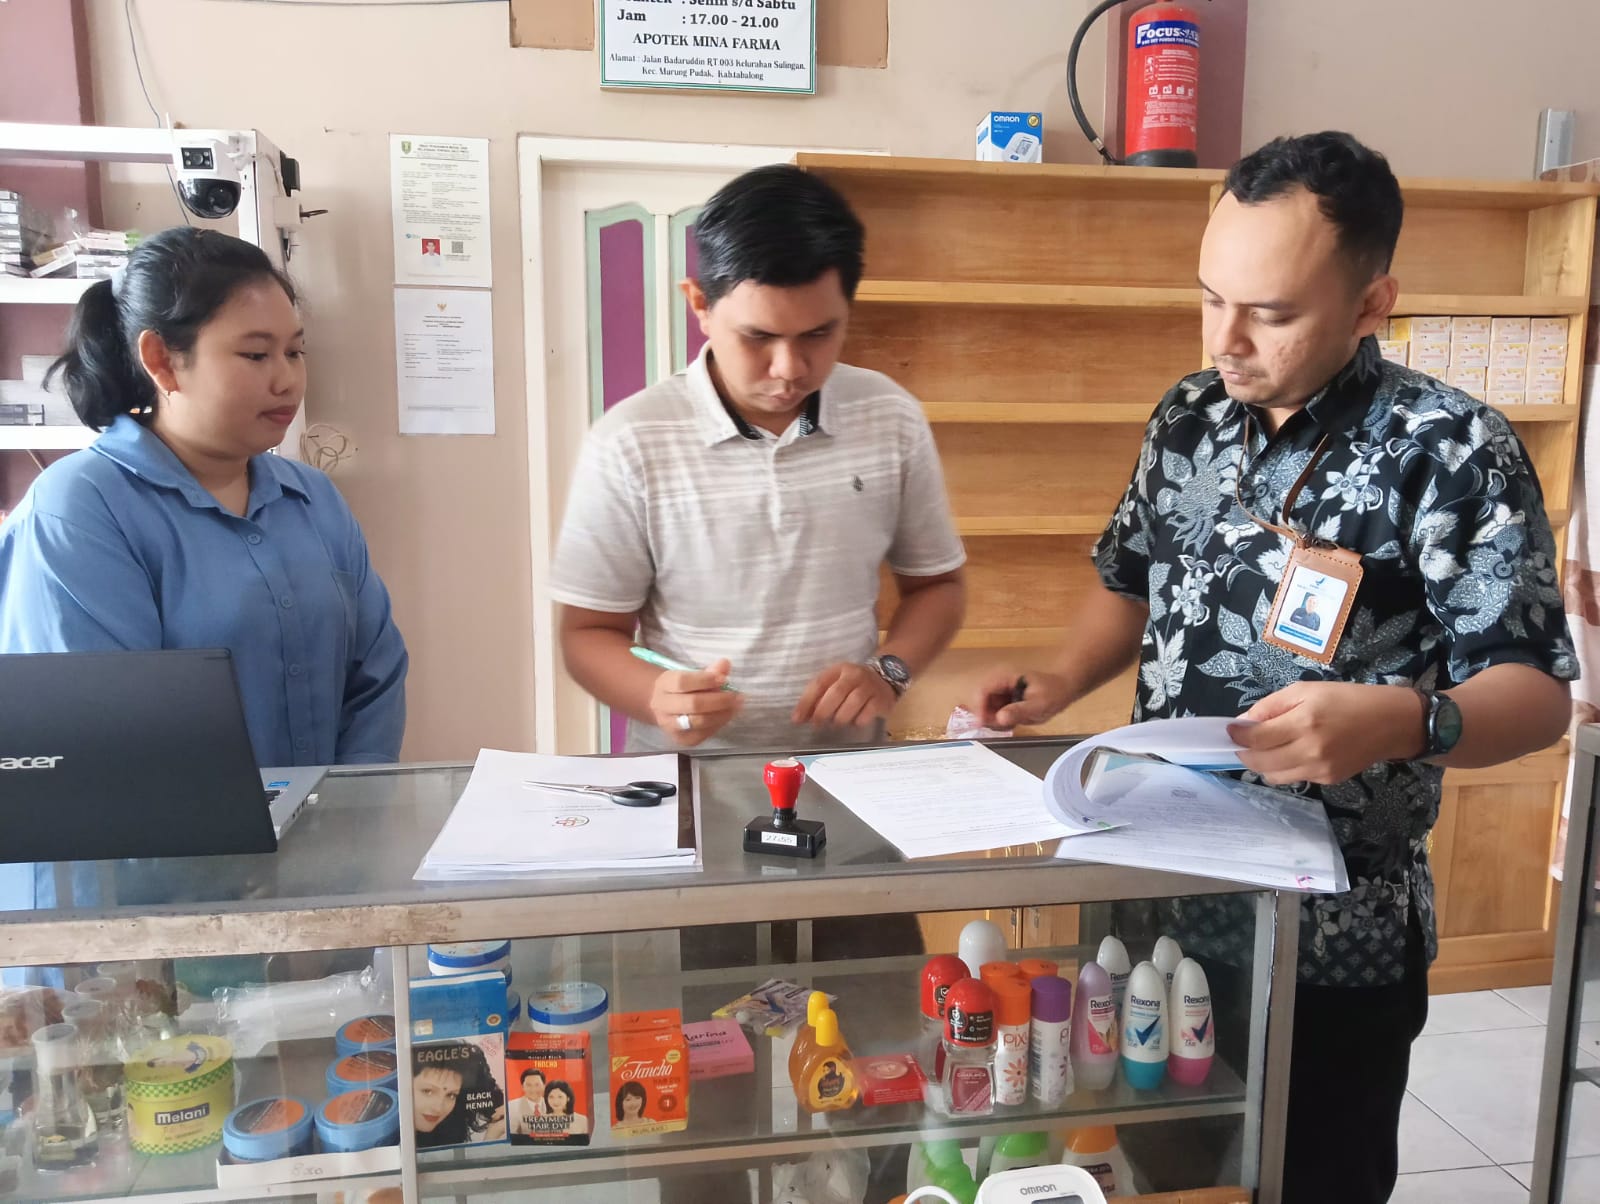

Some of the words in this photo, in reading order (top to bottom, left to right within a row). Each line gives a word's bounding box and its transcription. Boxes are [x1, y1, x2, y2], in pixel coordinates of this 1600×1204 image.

[617, 9, 647, 21] Jam
[690, 14, 728, 25] 17.00
[741, 16, 779, 28] 21.00
[633, 33, 689, 46] APOTEK
[693, 36, 728, 48] MINA
[732, 38, 781, 50] FARMA
[610, 53, 635, 62] Alamat
[642, 55, 662, 63] Jalan
[736, 59, 772, 69] Kelurahan
[0, 755, 64, 769] acer
[1131, 994, 1161, 1008] Rexona
[417, 1046, 471, 1063] EAGLE'S
[466, 1091, 492, 1101] BLACK
[465, 1100, 494, 1110] HENNA
[522, 1114, 574, 1123] TREATMENT
